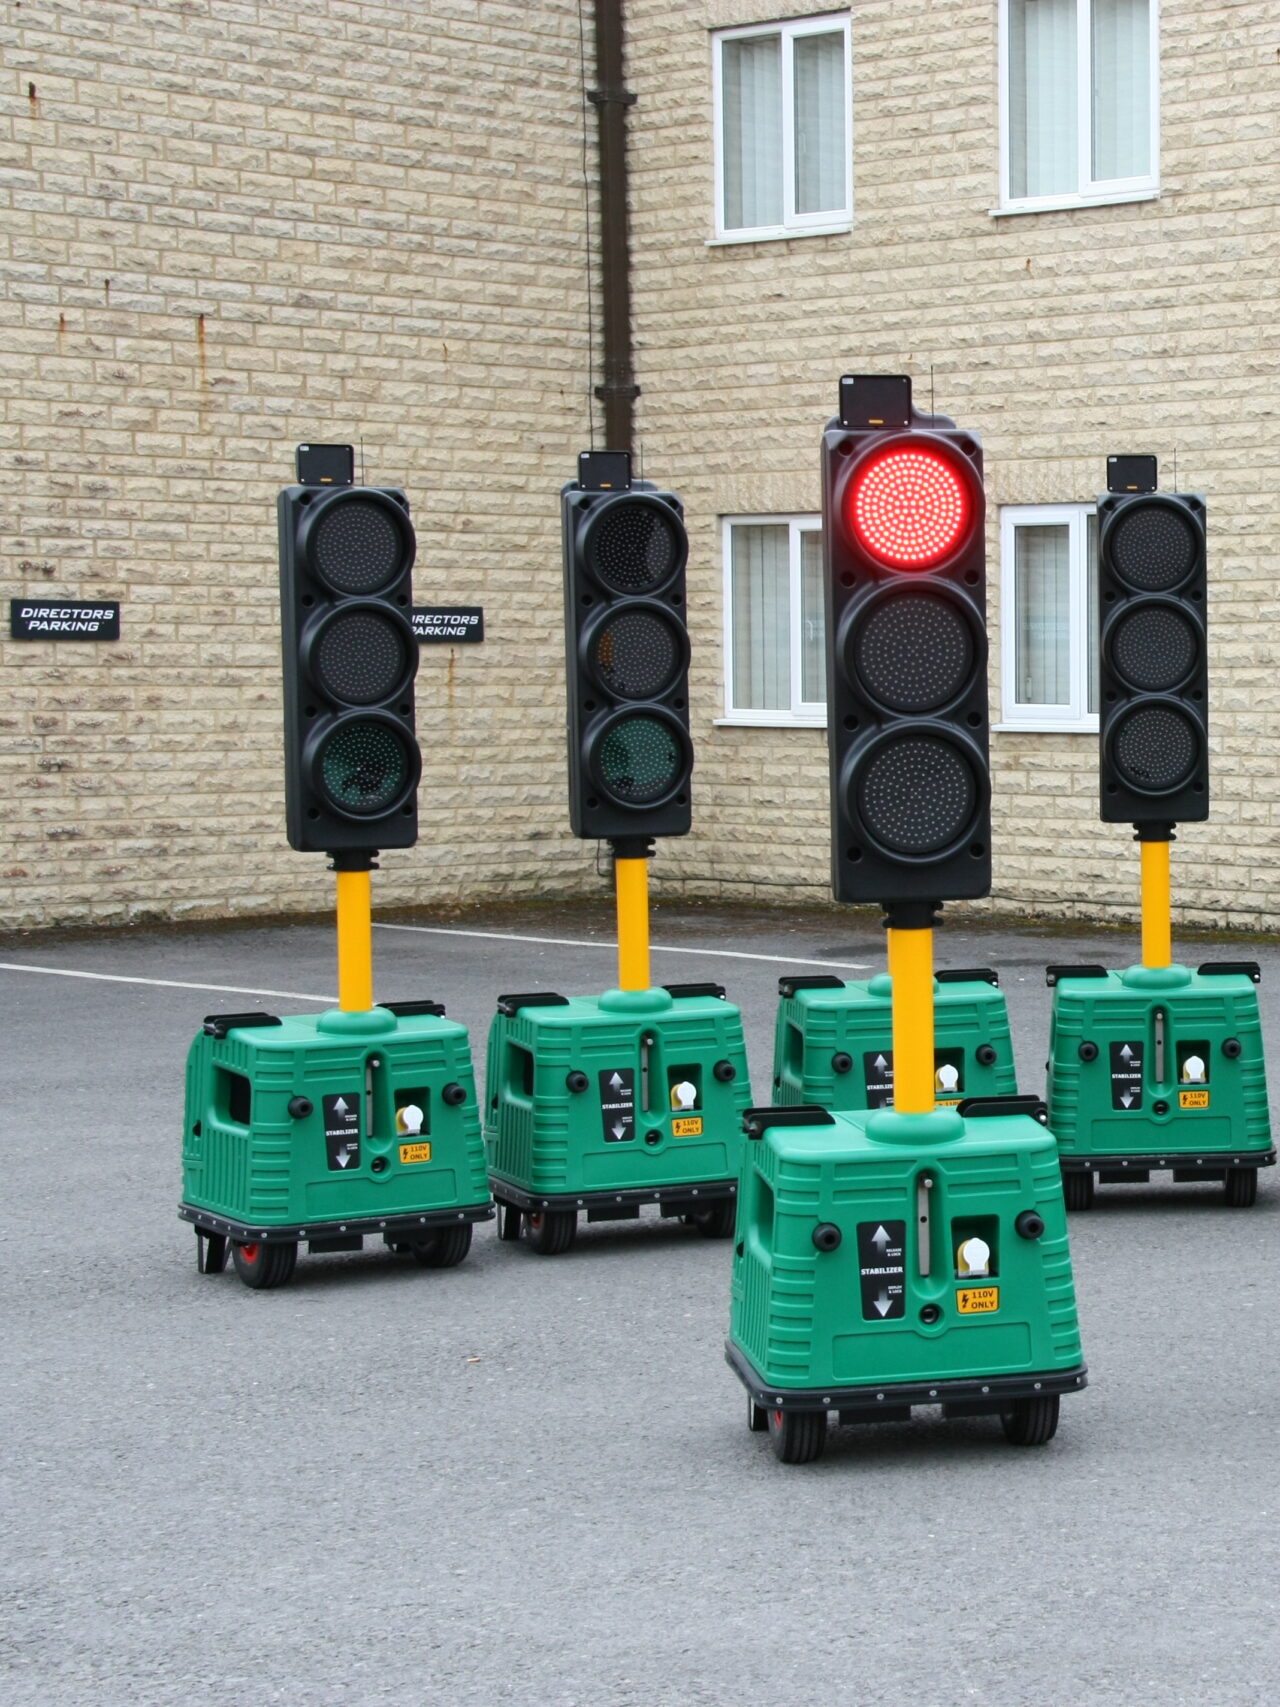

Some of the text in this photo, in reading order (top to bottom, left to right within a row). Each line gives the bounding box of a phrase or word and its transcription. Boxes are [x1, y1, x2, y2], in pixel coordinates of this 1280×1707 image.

[21, 608, 114, 619] DIRECTORS
[412, 615, 479, 625] IRECTORS
[28, 620, 100, 631] PARKING
[861, 1266, 903, 1275] STABILIZER
[972, 1290, 994, 1299] 110V
[971, 1301, 995, 1309] ONLY
